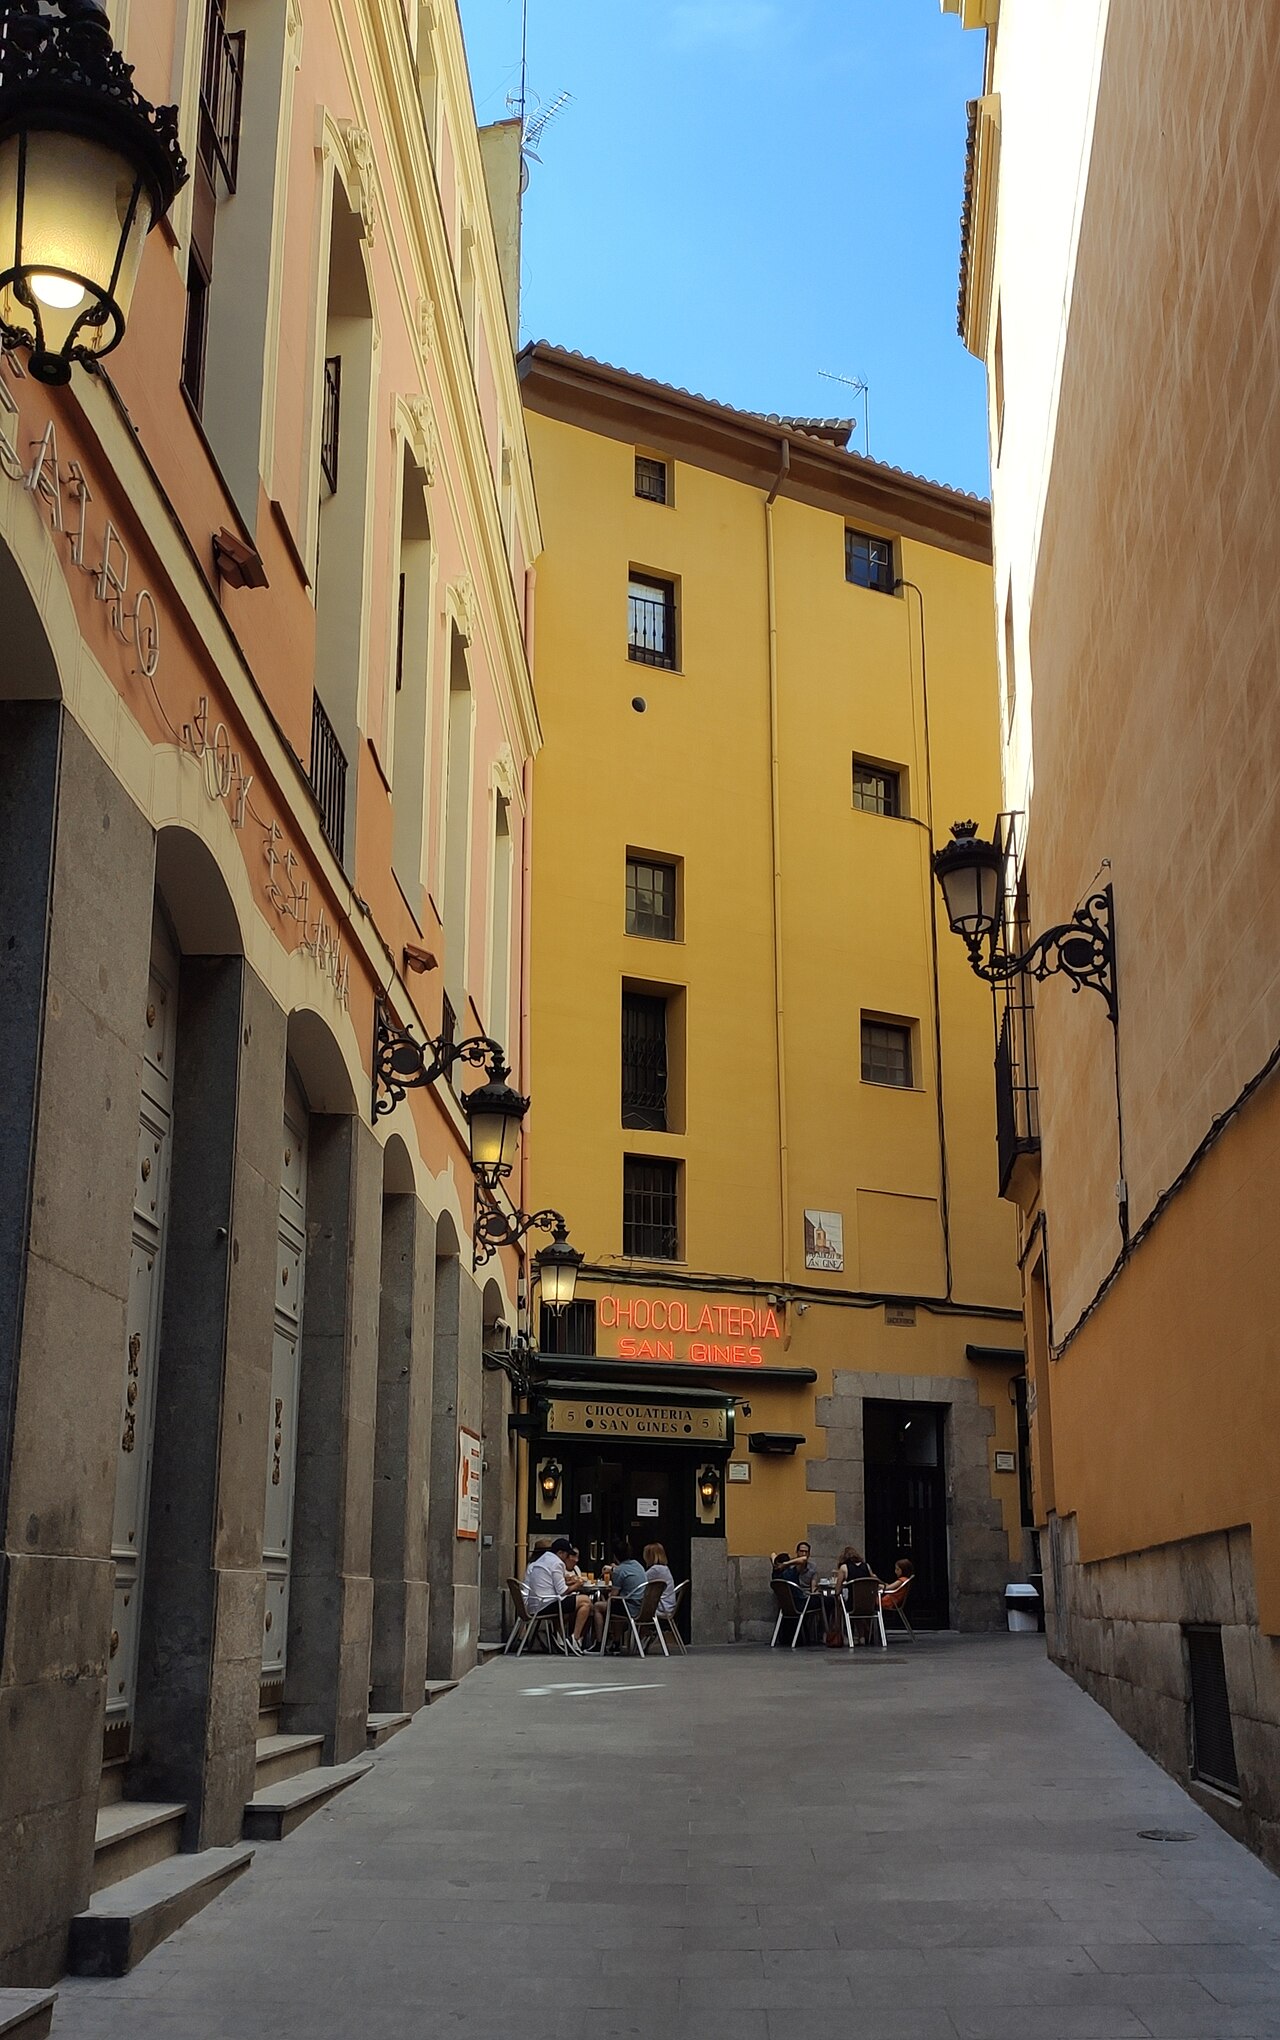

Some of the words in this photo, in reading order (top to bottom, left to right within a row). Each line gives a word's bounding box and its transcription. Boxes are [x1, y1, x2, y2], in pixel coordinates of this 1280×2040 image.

[600, 1295, 780, 1339] CHOCOLATERIA
[619, 1338, 675, 1360] SAN
[690, 1343, 763, 1365] GINES
[567, 1411, 575, 1421] 5
[585, 1404, 692, 1421] CHOCOLATERIA
[600, 1419, 629, 1431] SAN
[637, 1421, 678, 1434] GINES
[701, 1418, 709, 1429] 5
